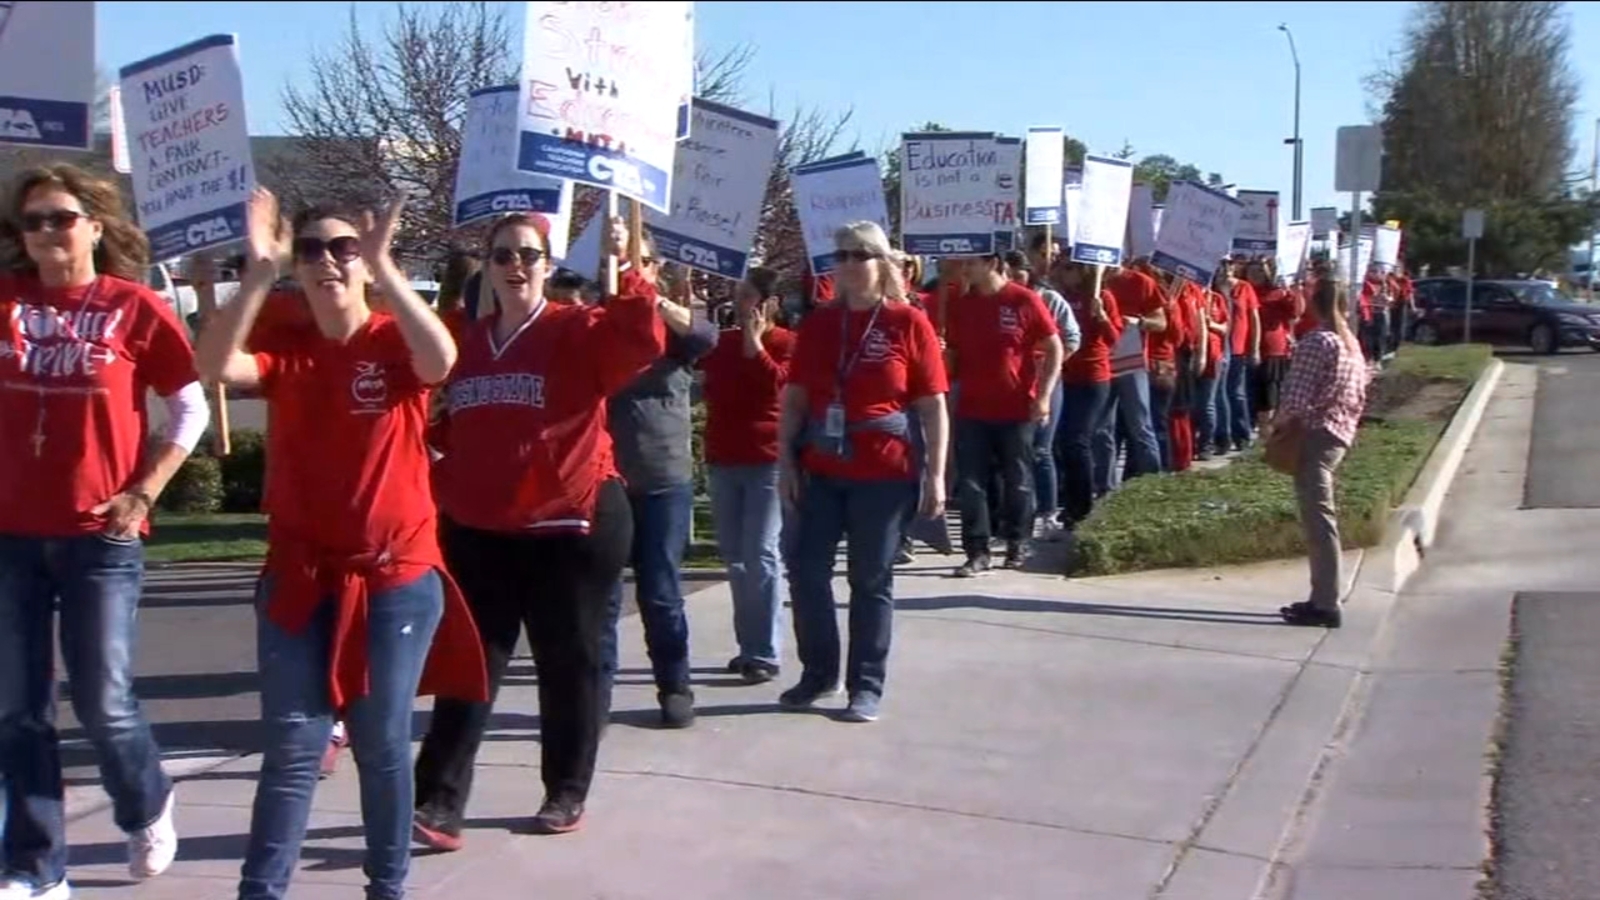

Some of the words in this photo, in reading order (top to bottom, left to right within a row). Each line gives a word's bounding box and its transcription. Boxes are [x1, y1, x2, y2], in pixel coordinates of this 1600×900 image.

[137, 103, 229, 151] TEACHERS
[165, 140, 201, 164] FAIR
[907, 140, 997, 171] Education
[200, 178, 223, 195] THE
[588, 155, 644, 195] CTA
[915, 174, 931, 188] is
[937, 168, 961, 186] not
[970, 174, 980, 182] a
[491, 194, 532, 211] CTA
[186, 215, 234, 247] CTA
[680, 243, 720, 270] CTA
[939, 238, 974, 252] CTA
